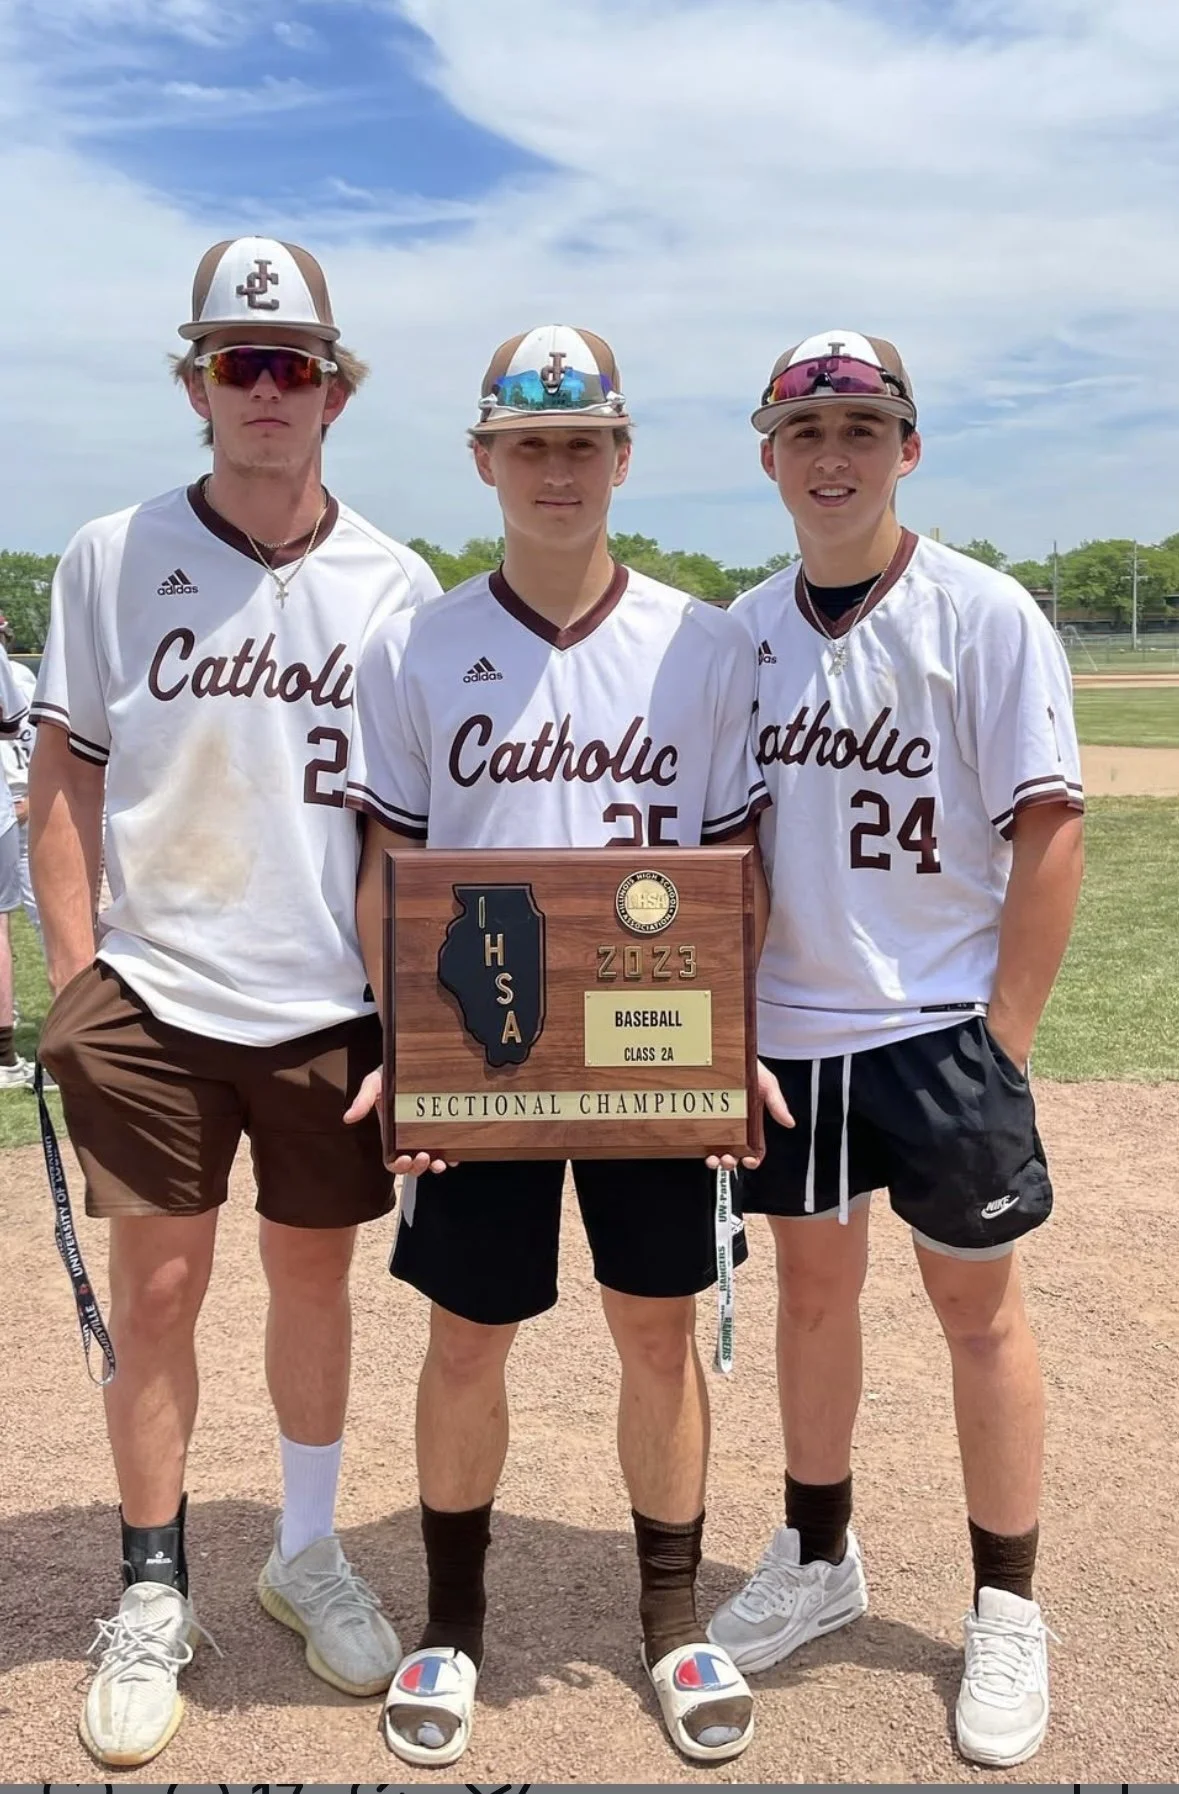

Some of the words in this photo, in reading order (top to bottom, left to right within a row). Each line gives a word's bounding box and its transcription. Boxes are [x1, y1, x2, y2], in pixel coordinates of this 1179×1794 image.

[236, 259, 279, 310] JC
[157, 584, 199, 596] adidas
[148, 627, 354, 709] Catholi
[462, 671, 503, 684] adidas
[448, 712, 679, 788] Catholic
[754, 700, 934, 778] atholic
[303, 725, 350, 808] 2
[849, 788, 941, 875] 24
[618, 878, 635, 911] ILLINOIS
[636, 872, 659, 881] HIGH
[660, 877, 677, 911] SCHOOL
[622, 913, 673, 931] ASSOCIATION
[597, 945, 698, 981] 2023
[614, 1009, 683, 1028] BASEBALL
[623, 1047, 656, 1063] CLASS
[661, 1047, 675, 1062] 2A
[415, 1094, 562, 1118] SECTIONAL
[579, 1090, 732, 1116] CHAMPIONS
[55, 1186, 67, 1204] OF
[985, 1194, 1011, 1211] NIKE
[58, 1206, 84, 1278] UNIVERSITY
